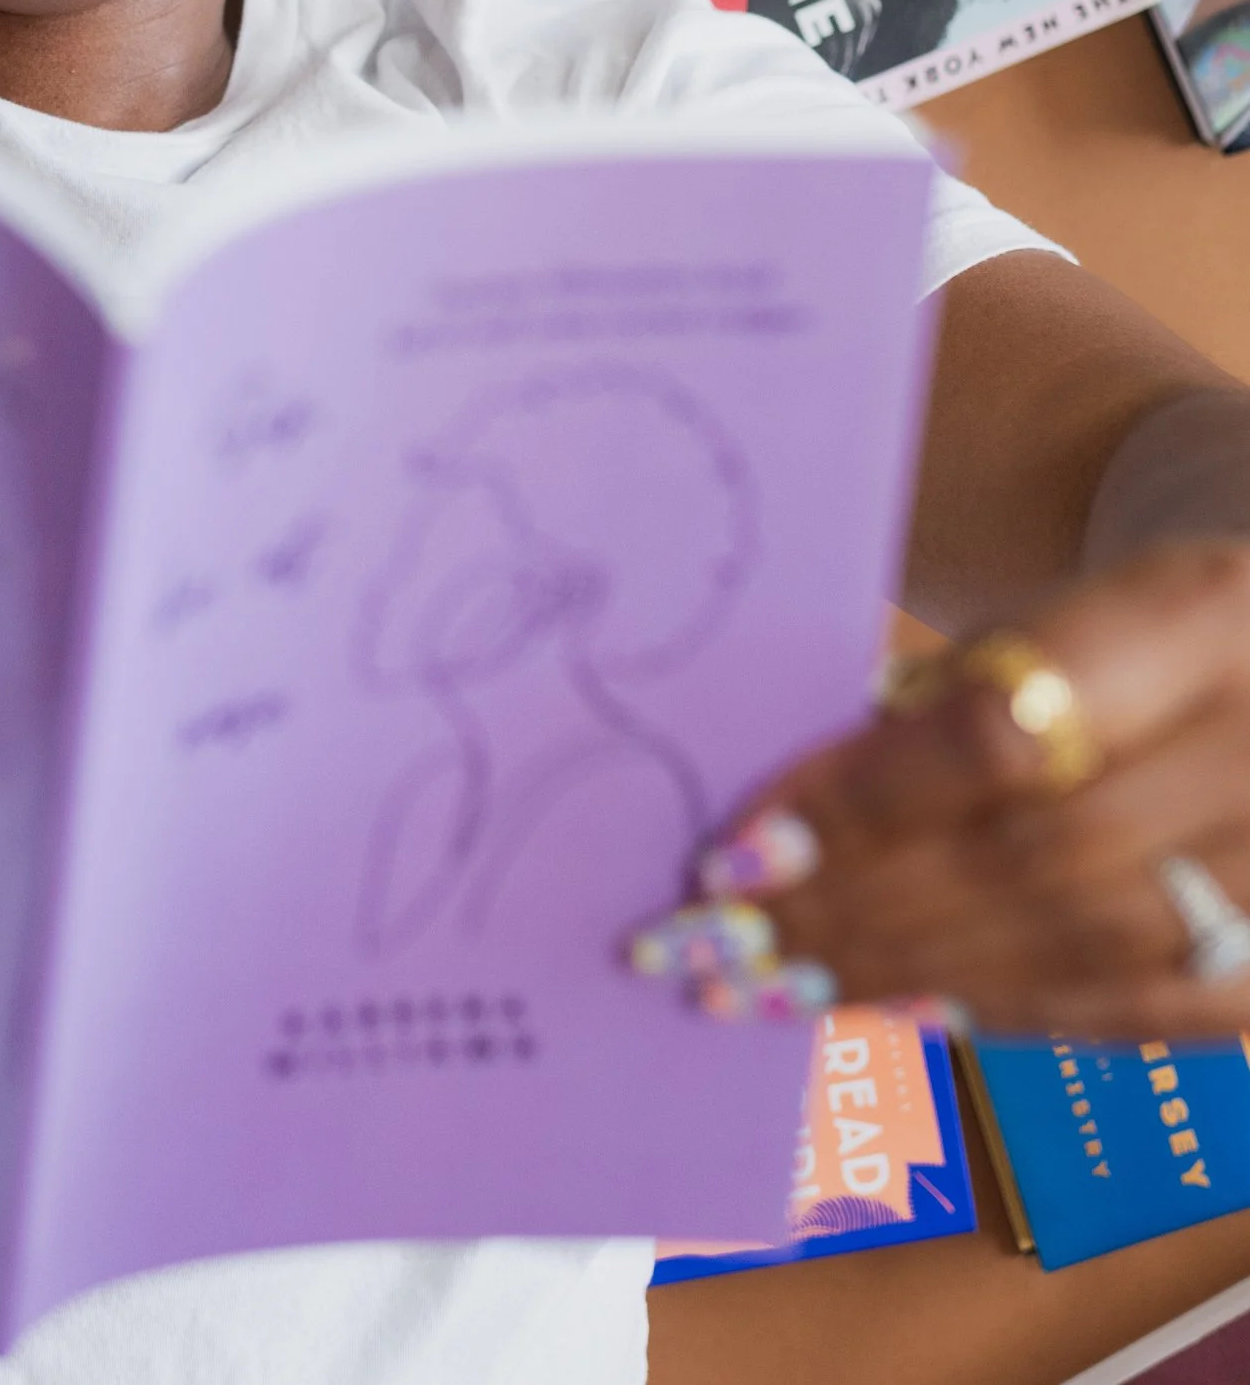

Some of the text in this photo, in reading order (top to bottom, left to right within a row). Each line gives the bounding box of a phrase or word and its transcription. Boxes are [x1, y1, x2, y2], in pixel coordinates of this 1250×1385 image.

[998, 17, 1058, 52] NEW
[905, 46, 983, 93] YORK
[1051, 1034, 1112, 1178] INISTRY
